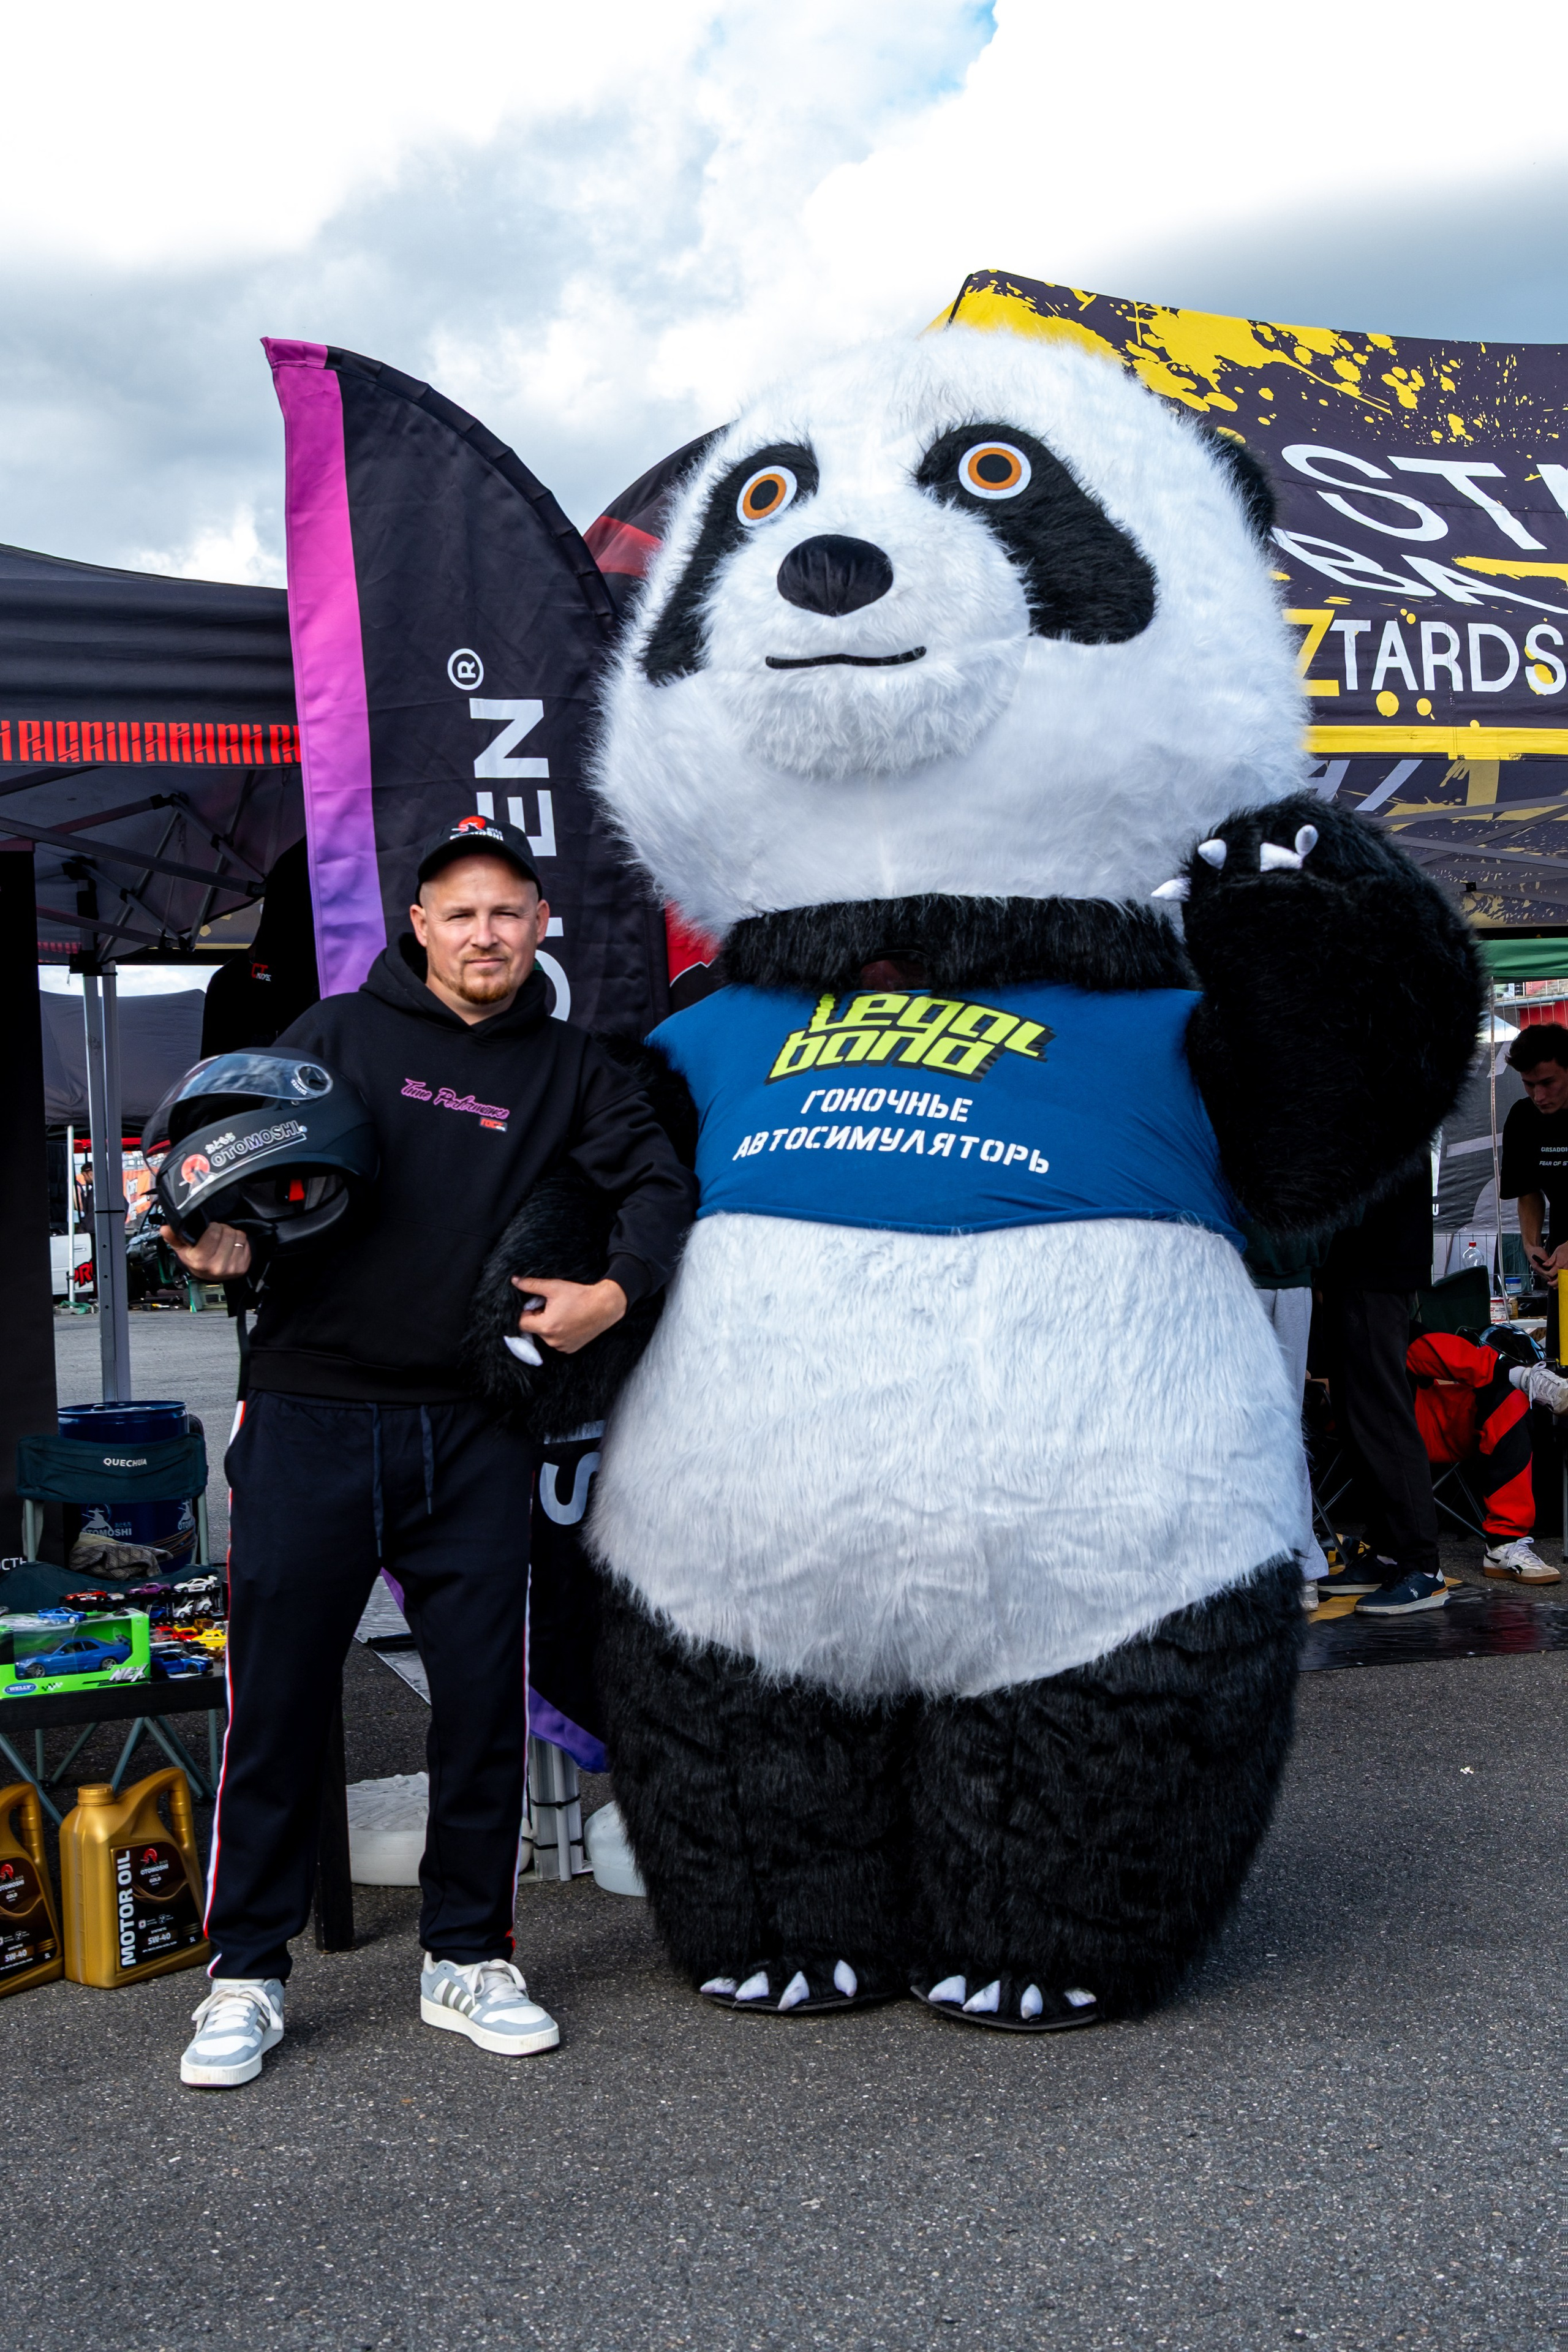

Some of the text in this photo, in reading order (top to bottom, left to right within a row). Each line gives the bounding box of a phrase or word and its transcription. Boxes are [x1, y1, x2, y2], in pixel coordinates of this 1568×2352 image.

[1281, 443, 1568, 550] ST
[433, 1088, 510, 1120] Performance
[211, 1120, 301, 1167] OTOMOSHI
[103, 1457, 148, 1467] QUECHUA
[109, 1663, 148, 1683] NEX
[117, 1850, 136, 1966] MOTOR OIL
